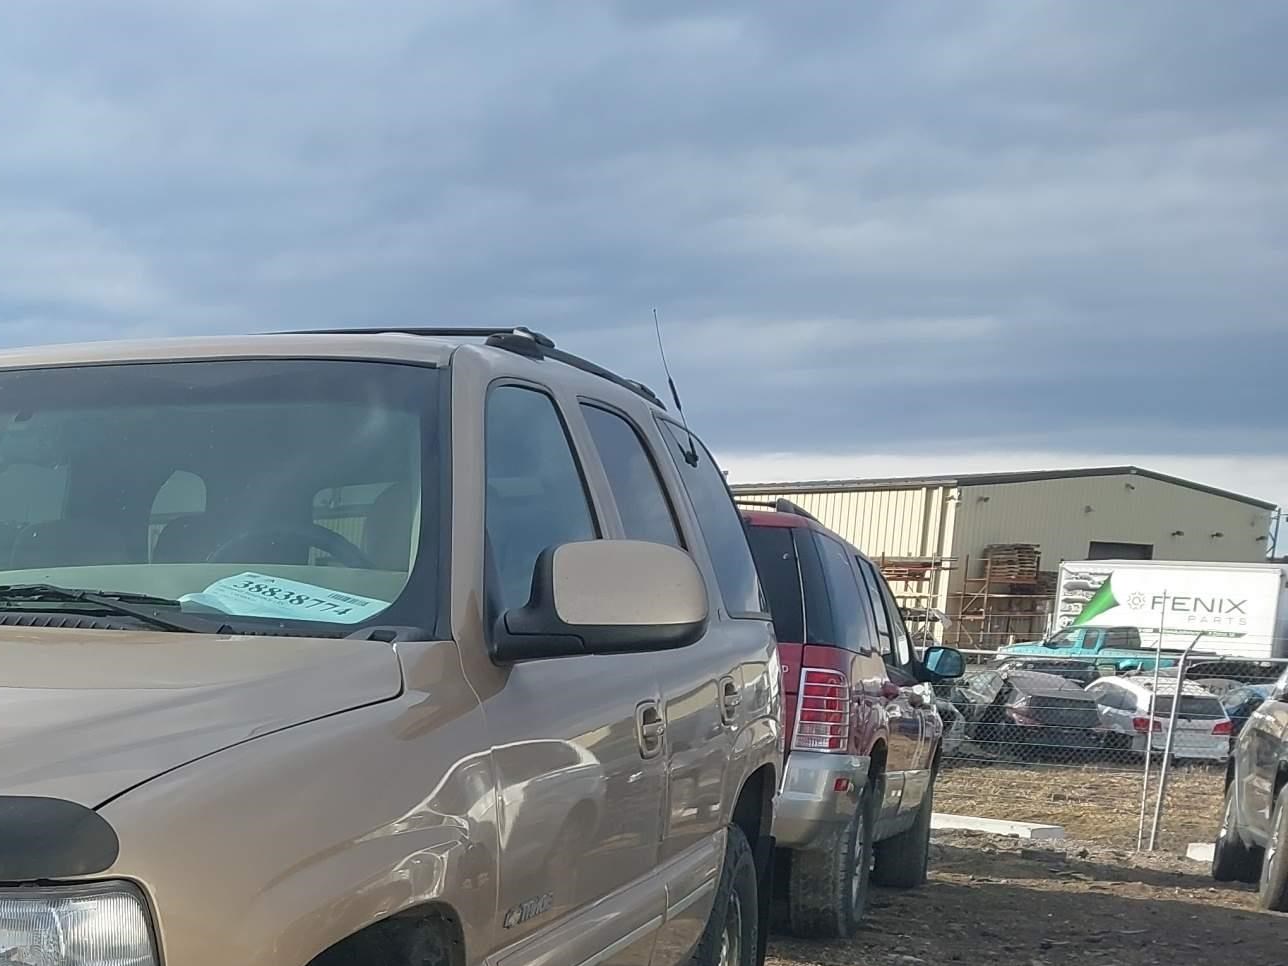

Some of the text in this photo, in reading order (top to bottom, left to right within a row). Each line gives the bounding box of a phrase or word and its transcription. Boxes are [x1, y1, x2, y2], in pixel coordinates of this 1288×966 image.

[233, 580, 353, 616] 38838774
[1151, 595, 1248, 614] FENIX
[1187, 615, 1247, 626] PARTS
